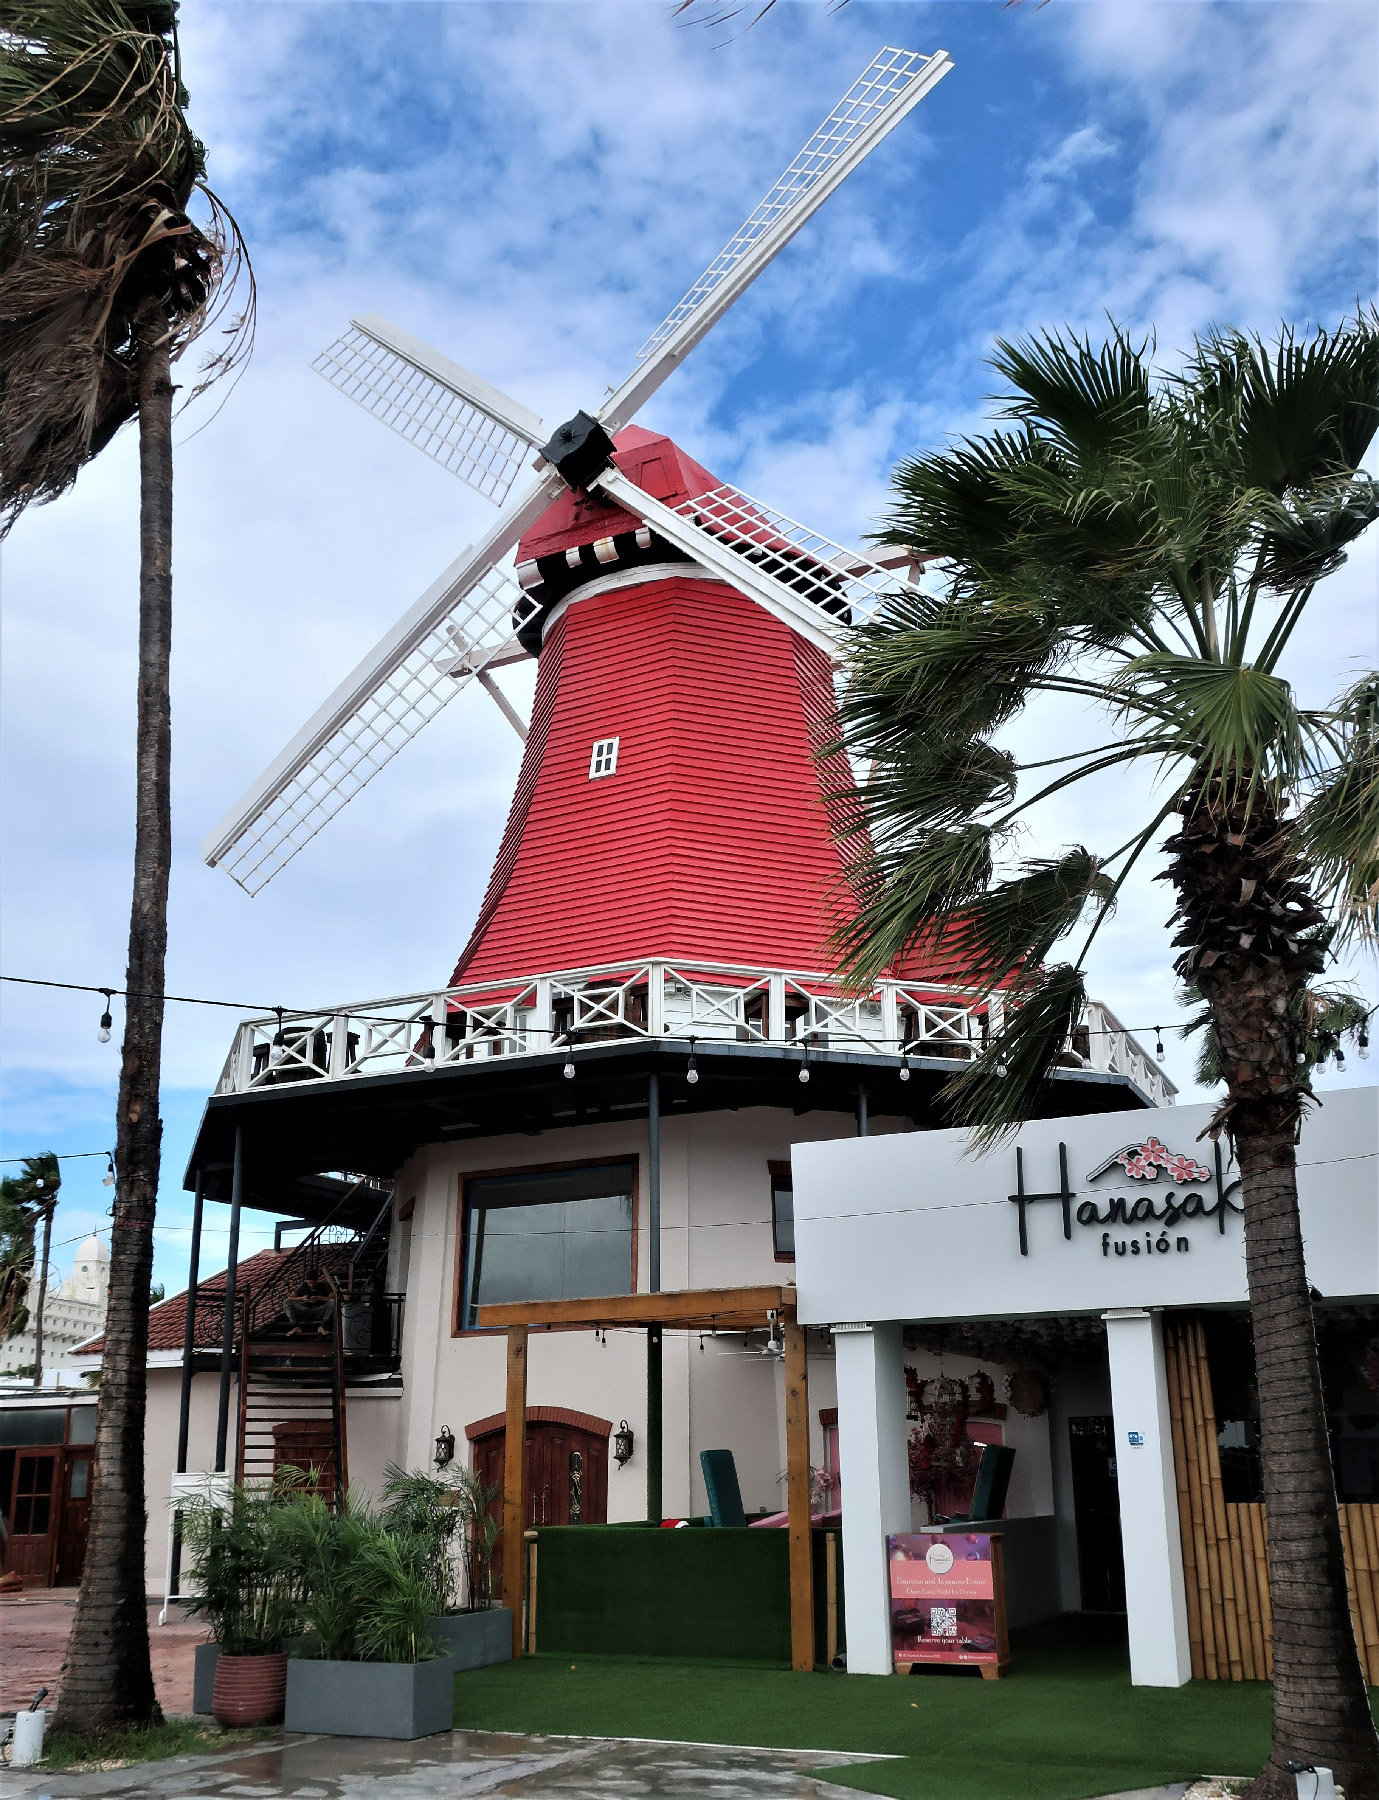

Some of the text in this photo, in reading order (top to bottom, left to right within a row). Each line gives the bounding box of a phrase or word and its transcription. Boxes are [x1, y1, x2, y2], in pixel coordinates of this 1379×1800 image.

[1101, 1231, 1190, 1257] fusión
[924, 1577, 936, 1585] and
[936, 1577, 966, 1586] Japanese
[936, 1588, 951, 1596] Night
[917, 1635, 941, 1643] Reserve
[956, 1636, 972, 1644] table
